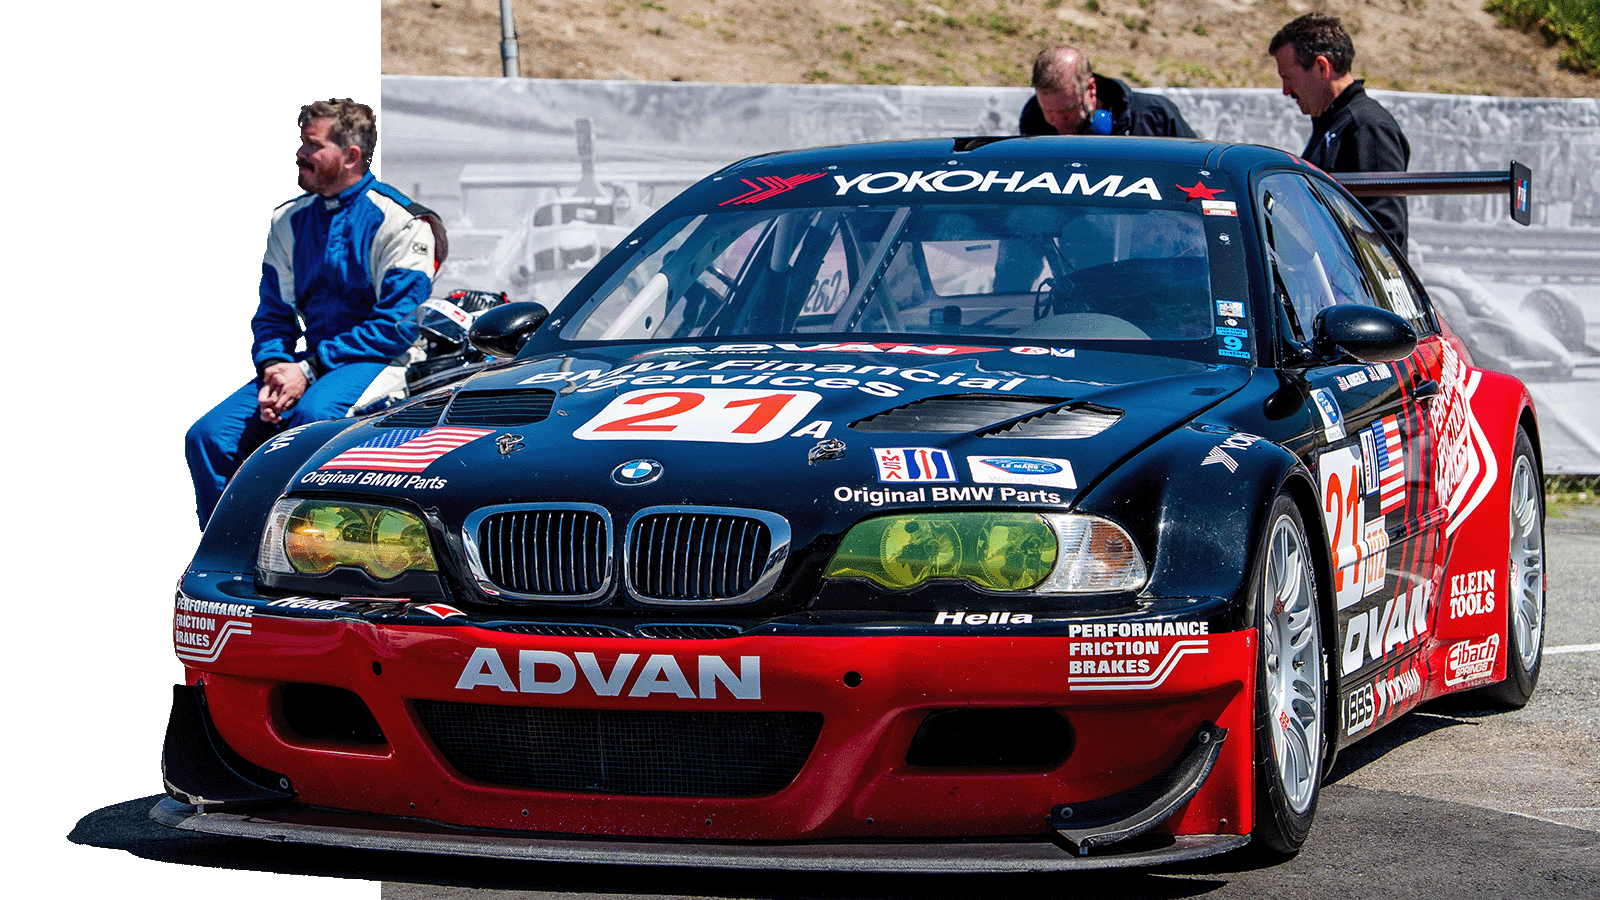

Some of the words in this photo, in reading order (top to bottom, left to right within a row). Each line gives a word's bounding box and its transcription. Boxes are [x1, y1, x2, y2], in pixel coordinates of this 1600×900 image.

[834, 169, 1163, 200] YOKOHAMA
[642, 343, 959, 356] ADVAN
[516, 360, 708, 392] BMW
[708, 360, 1027, 391] Financial
[577, 372, 904, 398] Services
[592, 392, 797, 434] 21
[790, 420, 833, 439] A
[881, 449, 903, 480] IMSA
[300, 471, 363, 486] Original
[358, 472, 408, 489] BMW
[403, 475, 448, 490] Parts
[988, 475, 1025, 483] World
[1028, 477, 1062, 486] Class
[833, 486, 926, 507] Original
[931, 487, 994, 502] BMW
[1000, 488, 1062, 504] Parts
[1326, 465, 1360, 593] 21
[1450, 569, 1496, 598] KLEIN
[176, 597, 255, 617] PERFORMANCE
[1450, 591, 1496, 619] TOOLS
[176, 613, 216, 631] FRICTION
[934, 612, 1034, 625] Hella
[1068, 621, 1209, 638] PERFORMANCE
[1341, 579, 1431, 678] DVAN
[176, 630, 210, 647] BRAKES
[1069, 641, 1160, 656] FRICTION
[1447, 637, 1497, 669] Eibach
[455, 647, 761, 700] ADVAN
[1069, 659, 1151, 675] BRAKES
[1455, 661, 1489, 678] SPRINGS
[1348, 683, 1375, 736] BBS
